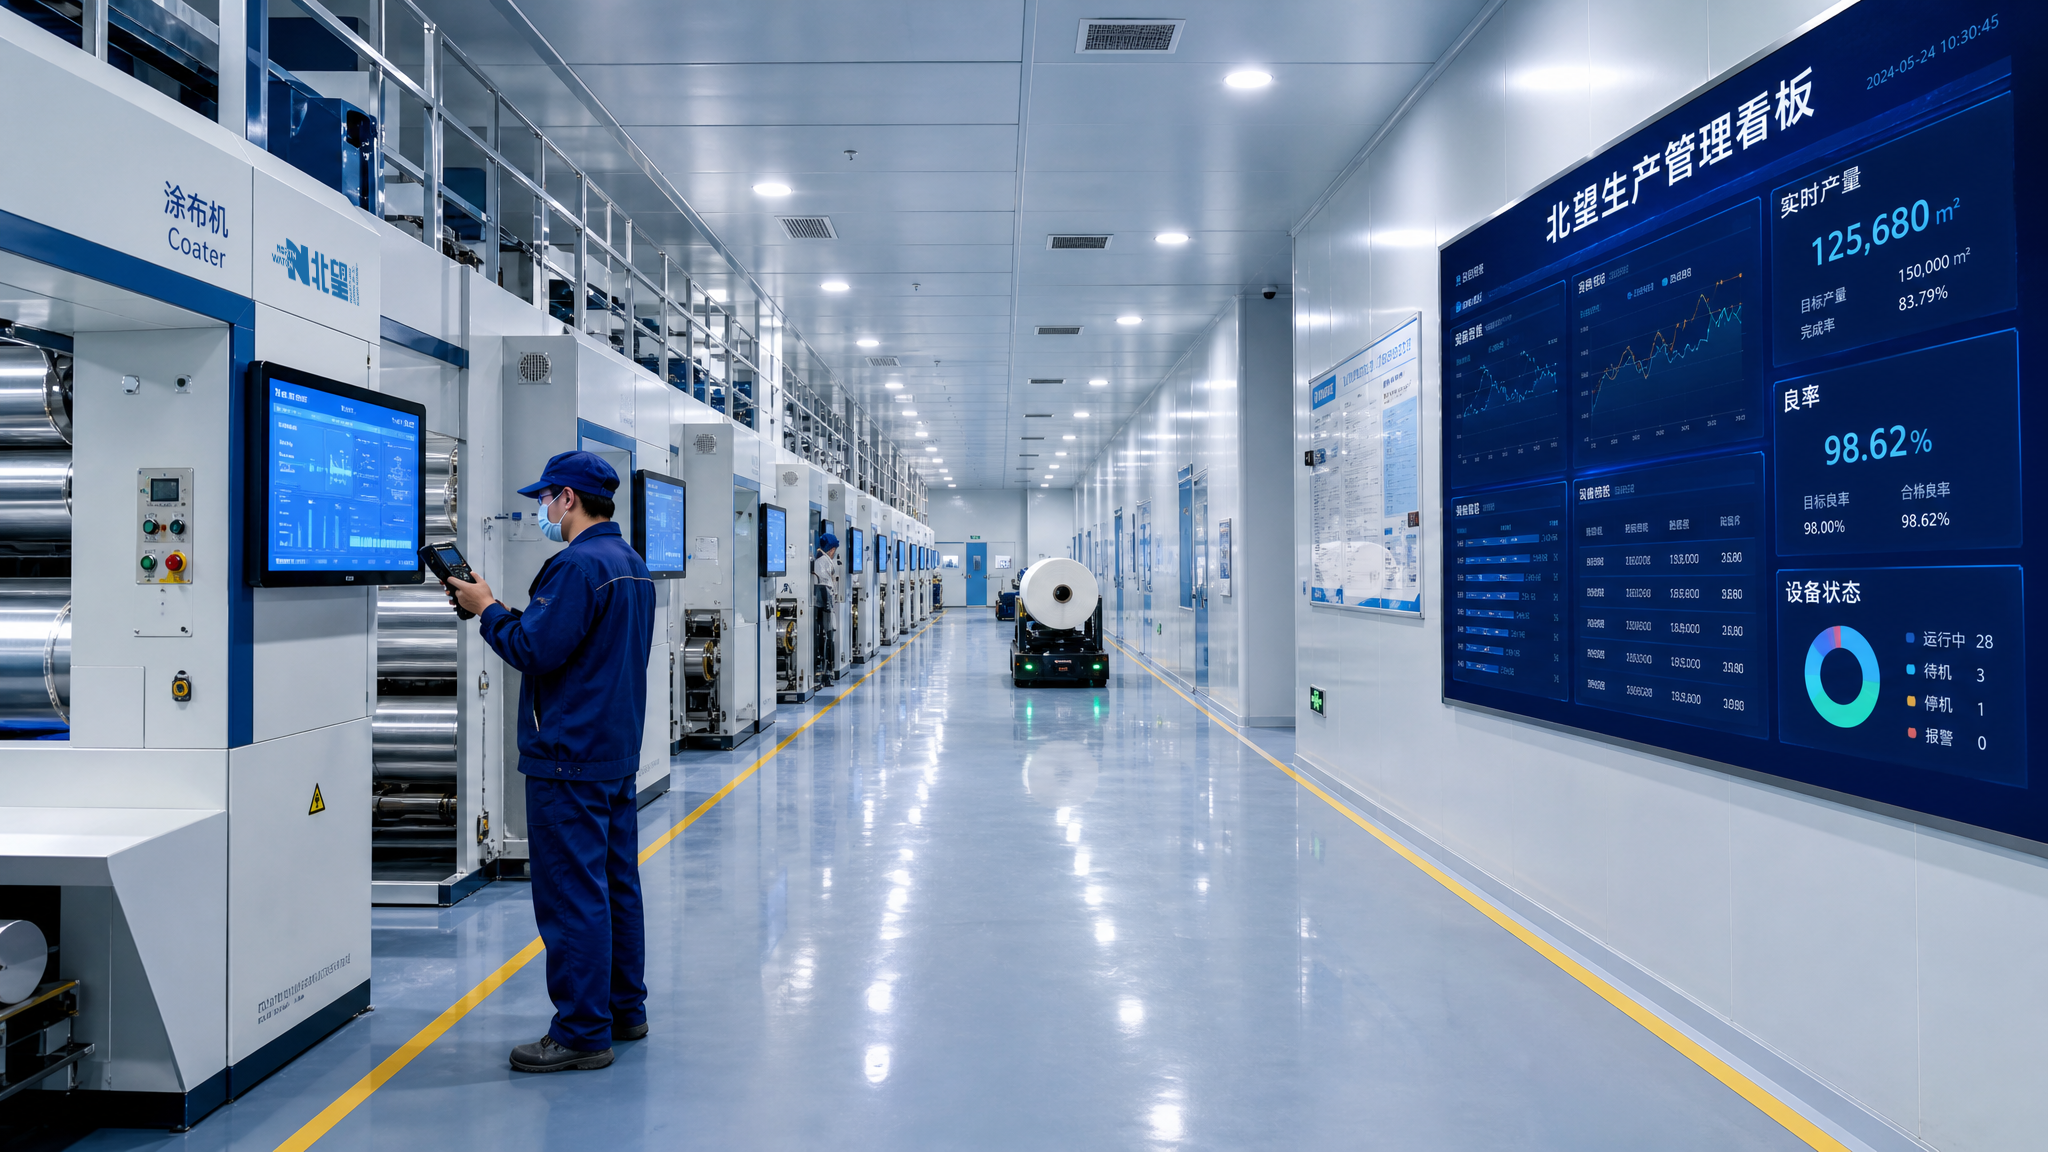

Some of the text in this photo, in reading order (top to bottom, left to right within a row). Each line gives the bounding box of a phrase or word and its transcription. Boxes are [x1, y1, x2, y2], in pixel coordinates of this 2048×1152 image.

[1866, 13, 1999, 91] 2024-05-24 10:30:45
[1546, 66, 1815, 244] 北望生产管理看板
[163, 180, 229, 239] 涂布机
[1780, 165, 1862, 220] 实时产量
[167, 226, 227, 269] Coater
[1811, 198, 1931, 266] 125,680
[310, 250, 349, 302] 北望
[1801, 286, 1847, 314] 目标产量
[1898, 254, 1950, 283] 150,000
[1800, 284, 1949, 341] 完成率 83.79%
[1784, 383, 1821, 414] 良率
[1824, 424, 1933, 466] 98.62%
[1803, 519, 1846, 535] 98.00%
[1901, 511, 1950, 529] 98.62%
[1785, 579, 1861, 604] 设备状态
[1923, 630, 1994, 650] 运行中 28
[1923, 662, 1985, 683] 待机 3
[1924, 694, 1984, 717] 停机 1
[1925, 727, 1987, 751] 报警 0
